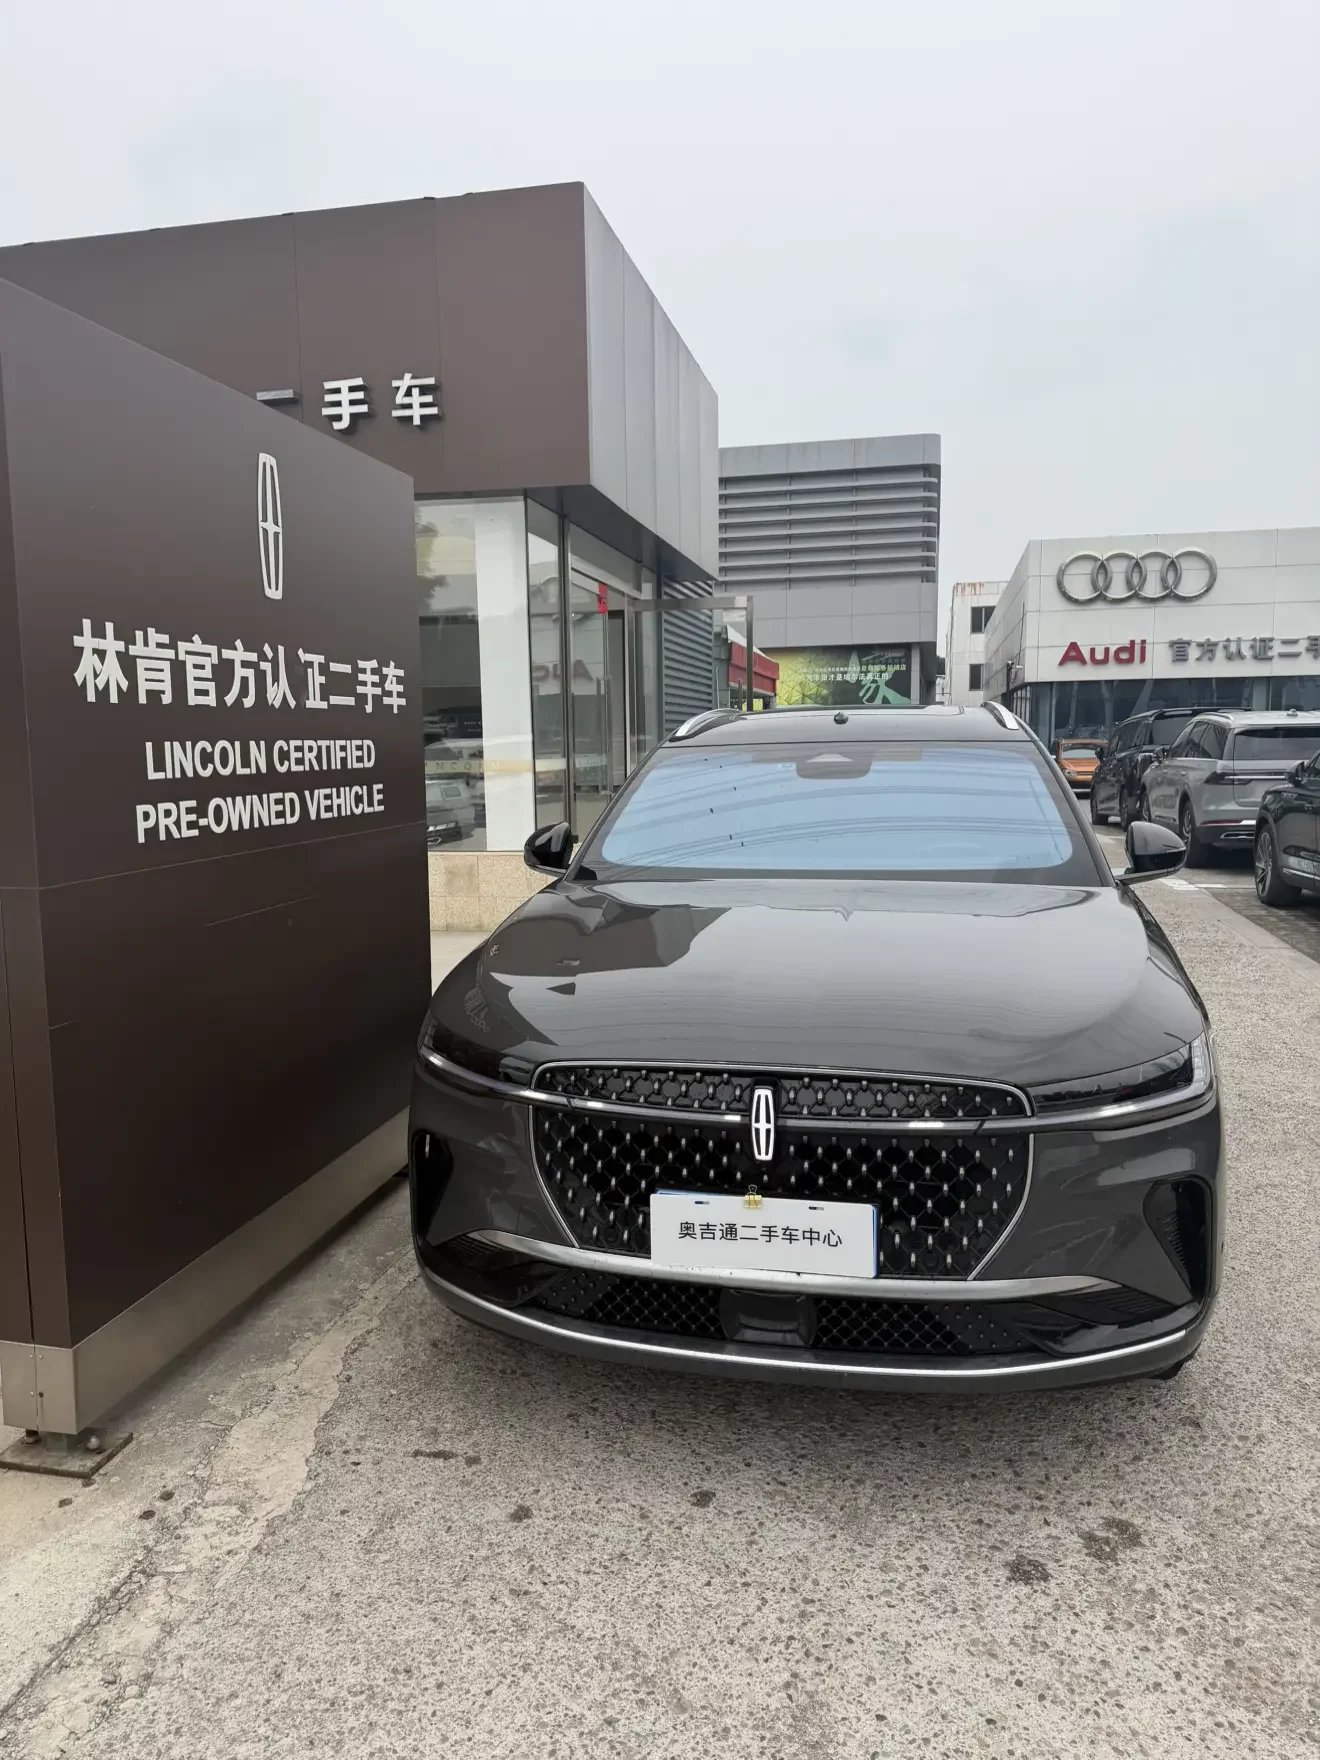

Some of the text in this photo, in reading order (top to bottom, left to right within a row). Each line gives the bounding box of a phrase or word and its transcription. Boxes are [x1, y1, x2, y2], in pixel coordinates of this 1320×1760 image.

[73, 618, 407, 714] 林肯官方认证二手车
[1058, 639, 1147, 666] Audi
[145, 739, 376, 780] LINCOLN CERTIFIED
[136, 783, 385, 844] PRE-OWNED VEHICLE
[678, 1221, 843, 1248] 奥吉通二手车中心
